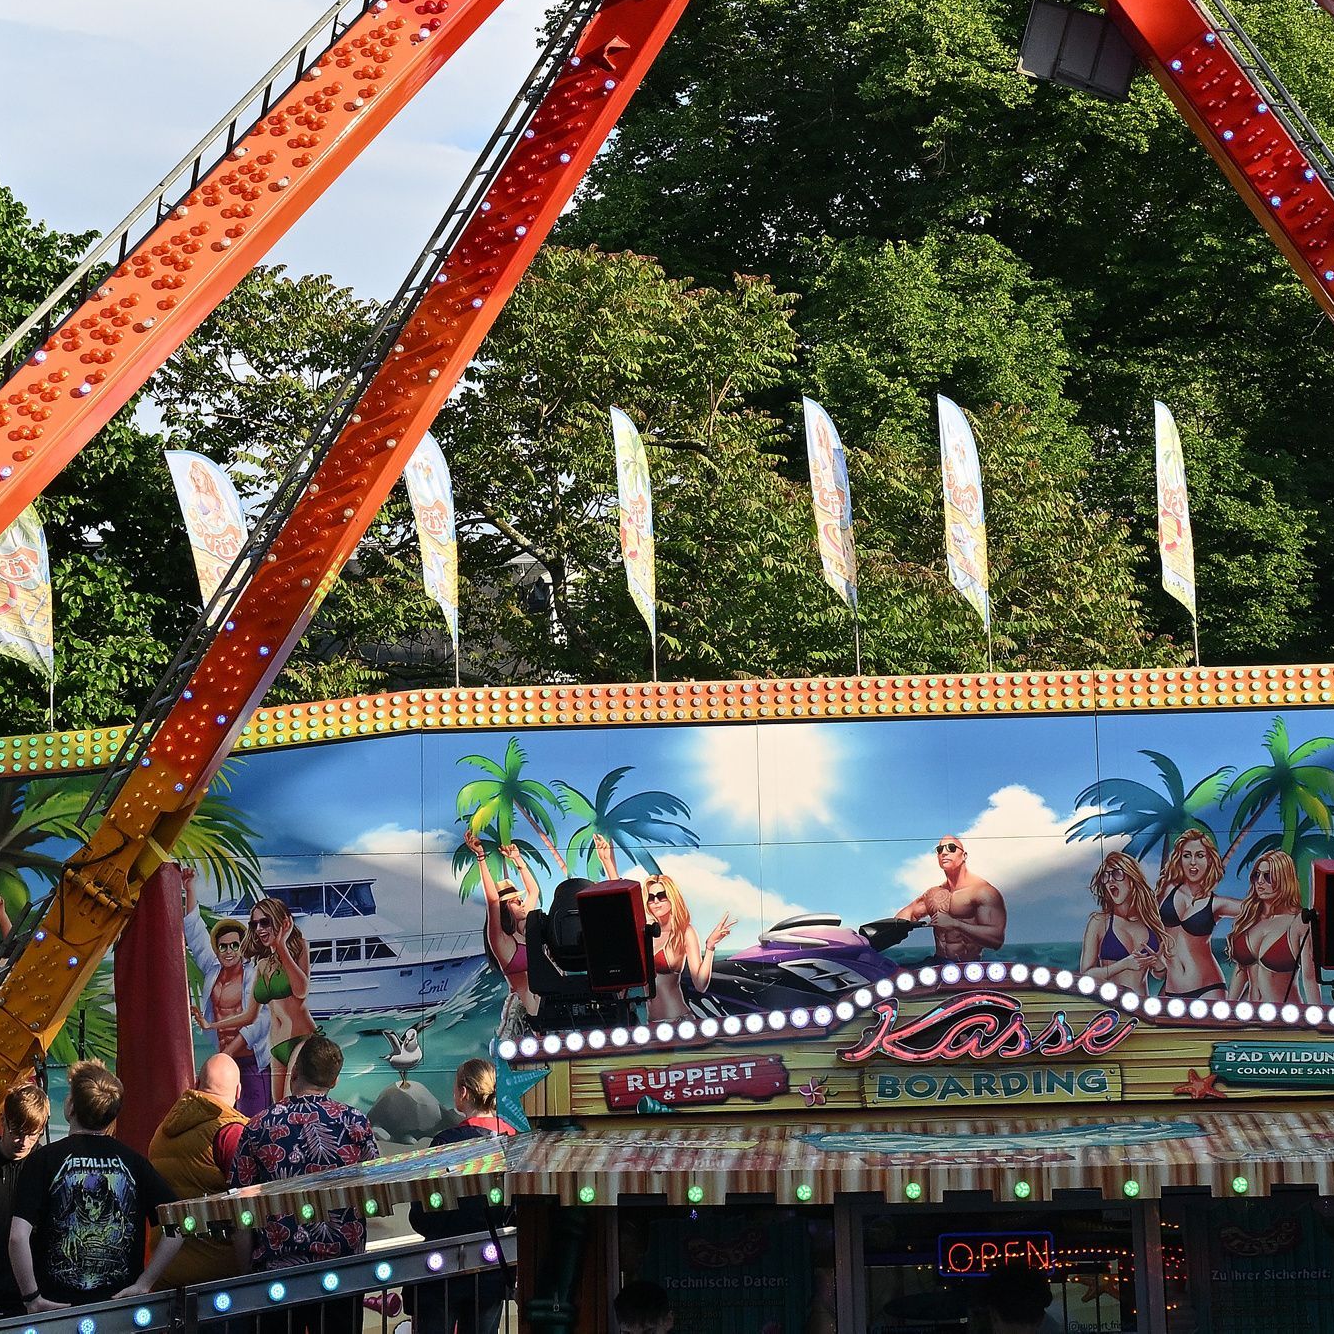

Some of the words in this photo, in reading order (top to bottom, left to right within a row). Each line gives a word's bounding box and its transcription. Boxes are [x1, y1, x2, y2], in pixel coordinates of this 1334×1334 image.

[418, 977, 449, 995] Emil
[836, 990, 1140, 1063] Kasse
[1225, 1050, 1263, 1063] BAD
[625, 1062, 757, 1092] RUPPERT
[876, 1068, 1108, 1102] BOARDING
[663, 1090, 676, 1100] &
[682, 1084, 725, 1098] Sohn
[948, 1240, 1049, 1273] OPEN
[665, 1275, 740, 1289] Technische
[744, 1275, 790, 1288] Daten:
[1211, 1269, 1227, 1282] Zu
[1231, 1269, 1261, 1281] Ihrer
[1263, 1269, 1332, 1281] Sicherheit:
